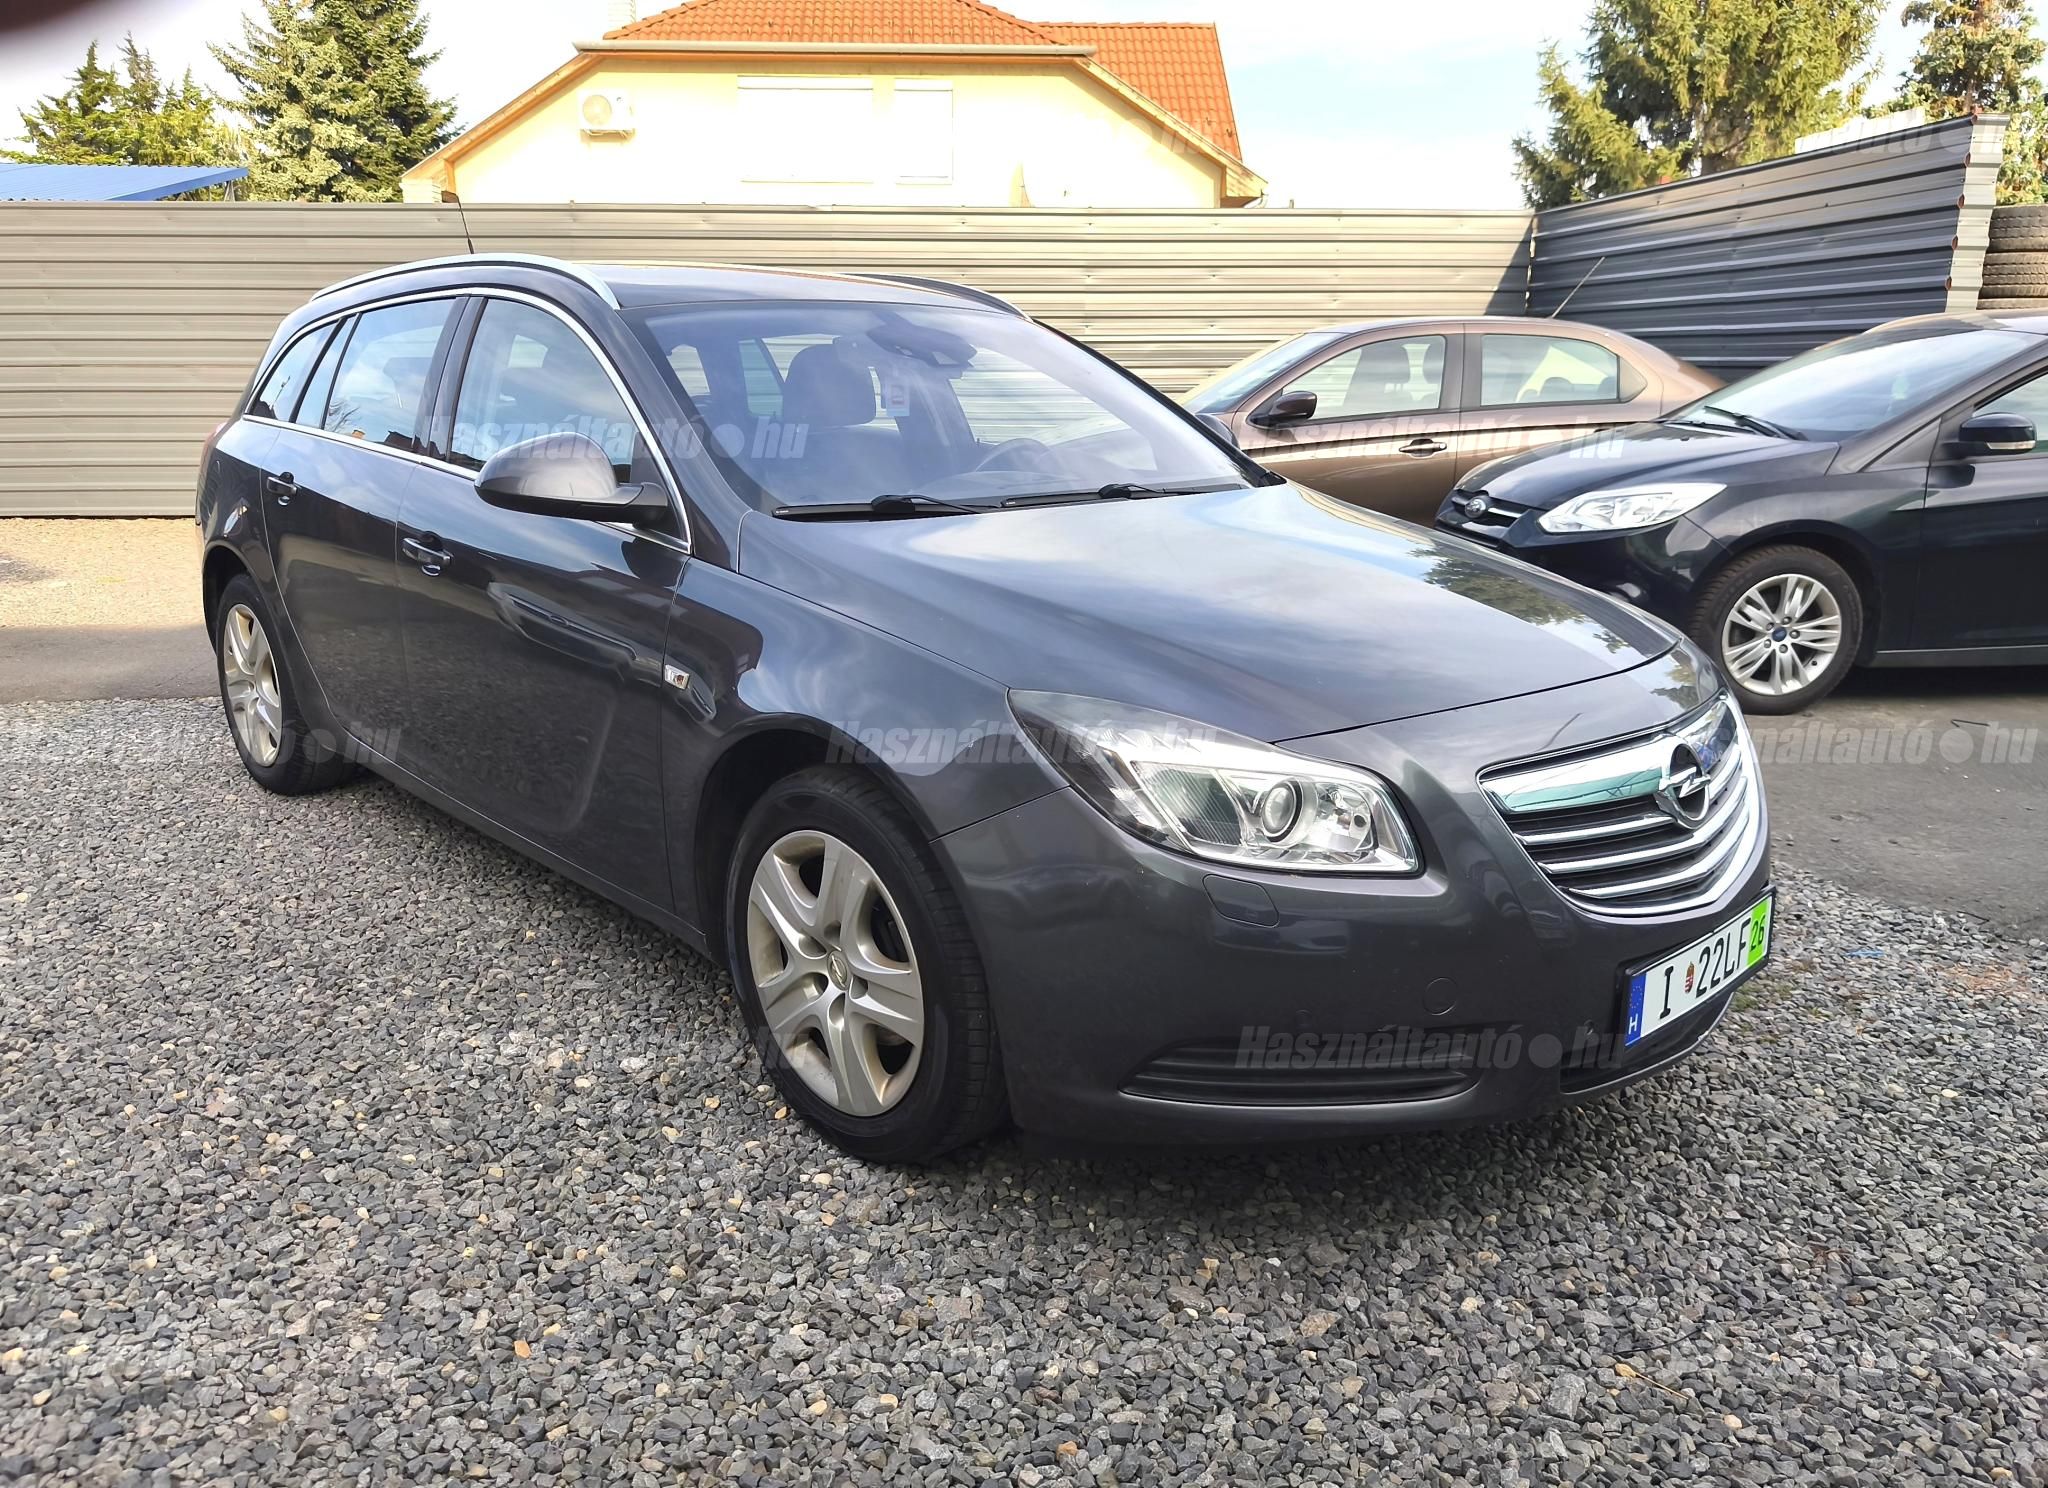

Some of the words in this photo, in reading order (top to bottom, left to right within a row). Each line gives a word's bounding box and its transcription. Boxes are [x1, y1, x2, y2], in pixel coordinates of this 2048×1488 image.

[1659, 965, 1674, 1019] I
[1695, 917, 1752, 998] 22LF
[1749, 914, 1766, 953] 26
[1627, 1013, 1638, 1035] H
